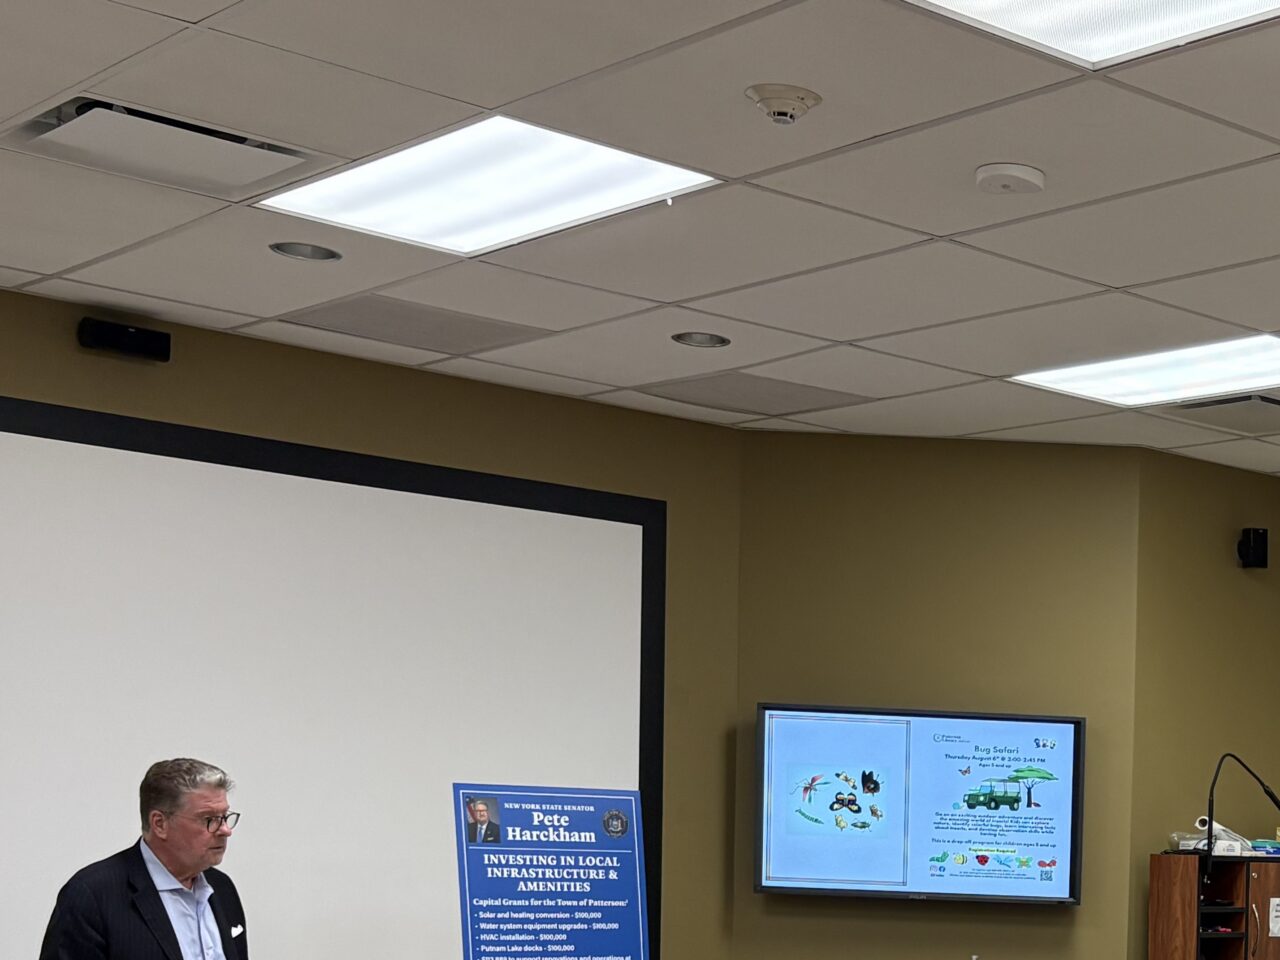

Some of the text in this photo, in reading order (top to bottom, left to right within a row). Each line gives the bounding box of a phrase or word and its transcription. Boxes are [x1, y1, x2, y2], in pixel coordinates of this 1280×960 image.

[974, 745, 990, 754] Bug
[532, 812, 569, 826] Pete
[506, 826, 596, 842] Harckham
[483, 854, 620, 867] INVESTING IN LOCAL
[487, 868, 618, 880] INFRASTRUCTURE &
[517, 882, 591, 892] AMENITIES
[473, 898, 501, 907] Capital
[511, 912, 534, 920] heating
[500, 923, 522, 931] system
[524, 922, 557, 930] equipment
[558, 922, 588, 931] upgrades
